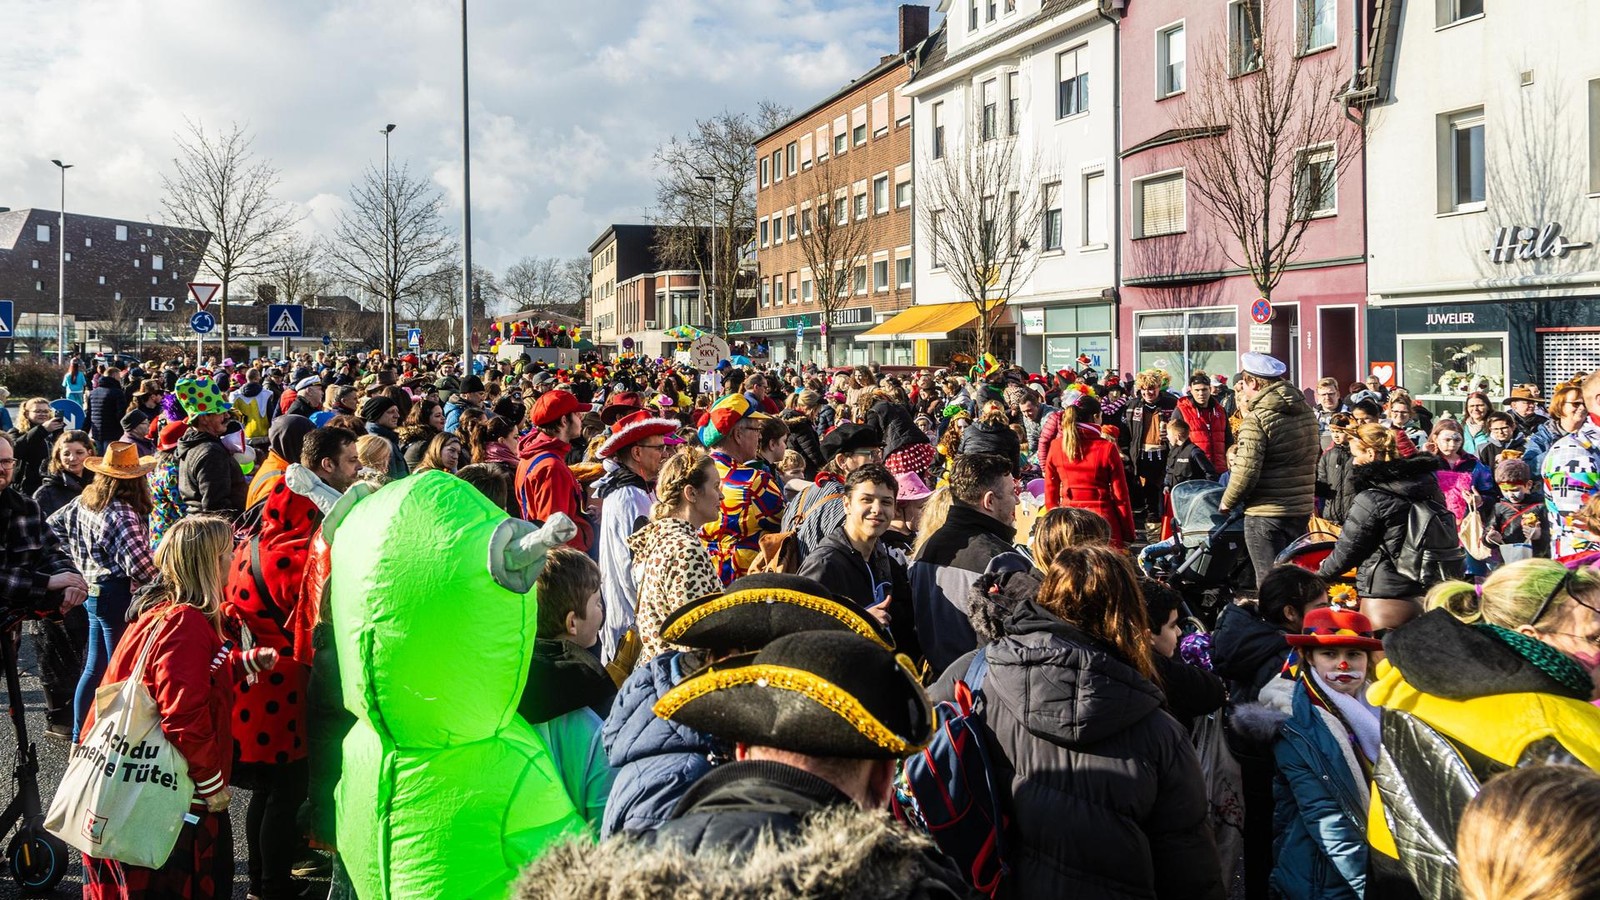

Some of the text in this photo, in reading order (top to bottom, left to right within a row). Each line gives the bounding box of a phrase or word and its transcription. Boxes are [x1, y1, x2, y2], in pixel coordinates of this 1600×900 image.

[1487, 222, 1574, 264] Hüls
[1425, 312, 1475, 325] JUWELIER
[703, 381, 709, 391] 6
[100, 720, 160, 760] Ach du
[75, 744, 178, 791] meine Tüte!
